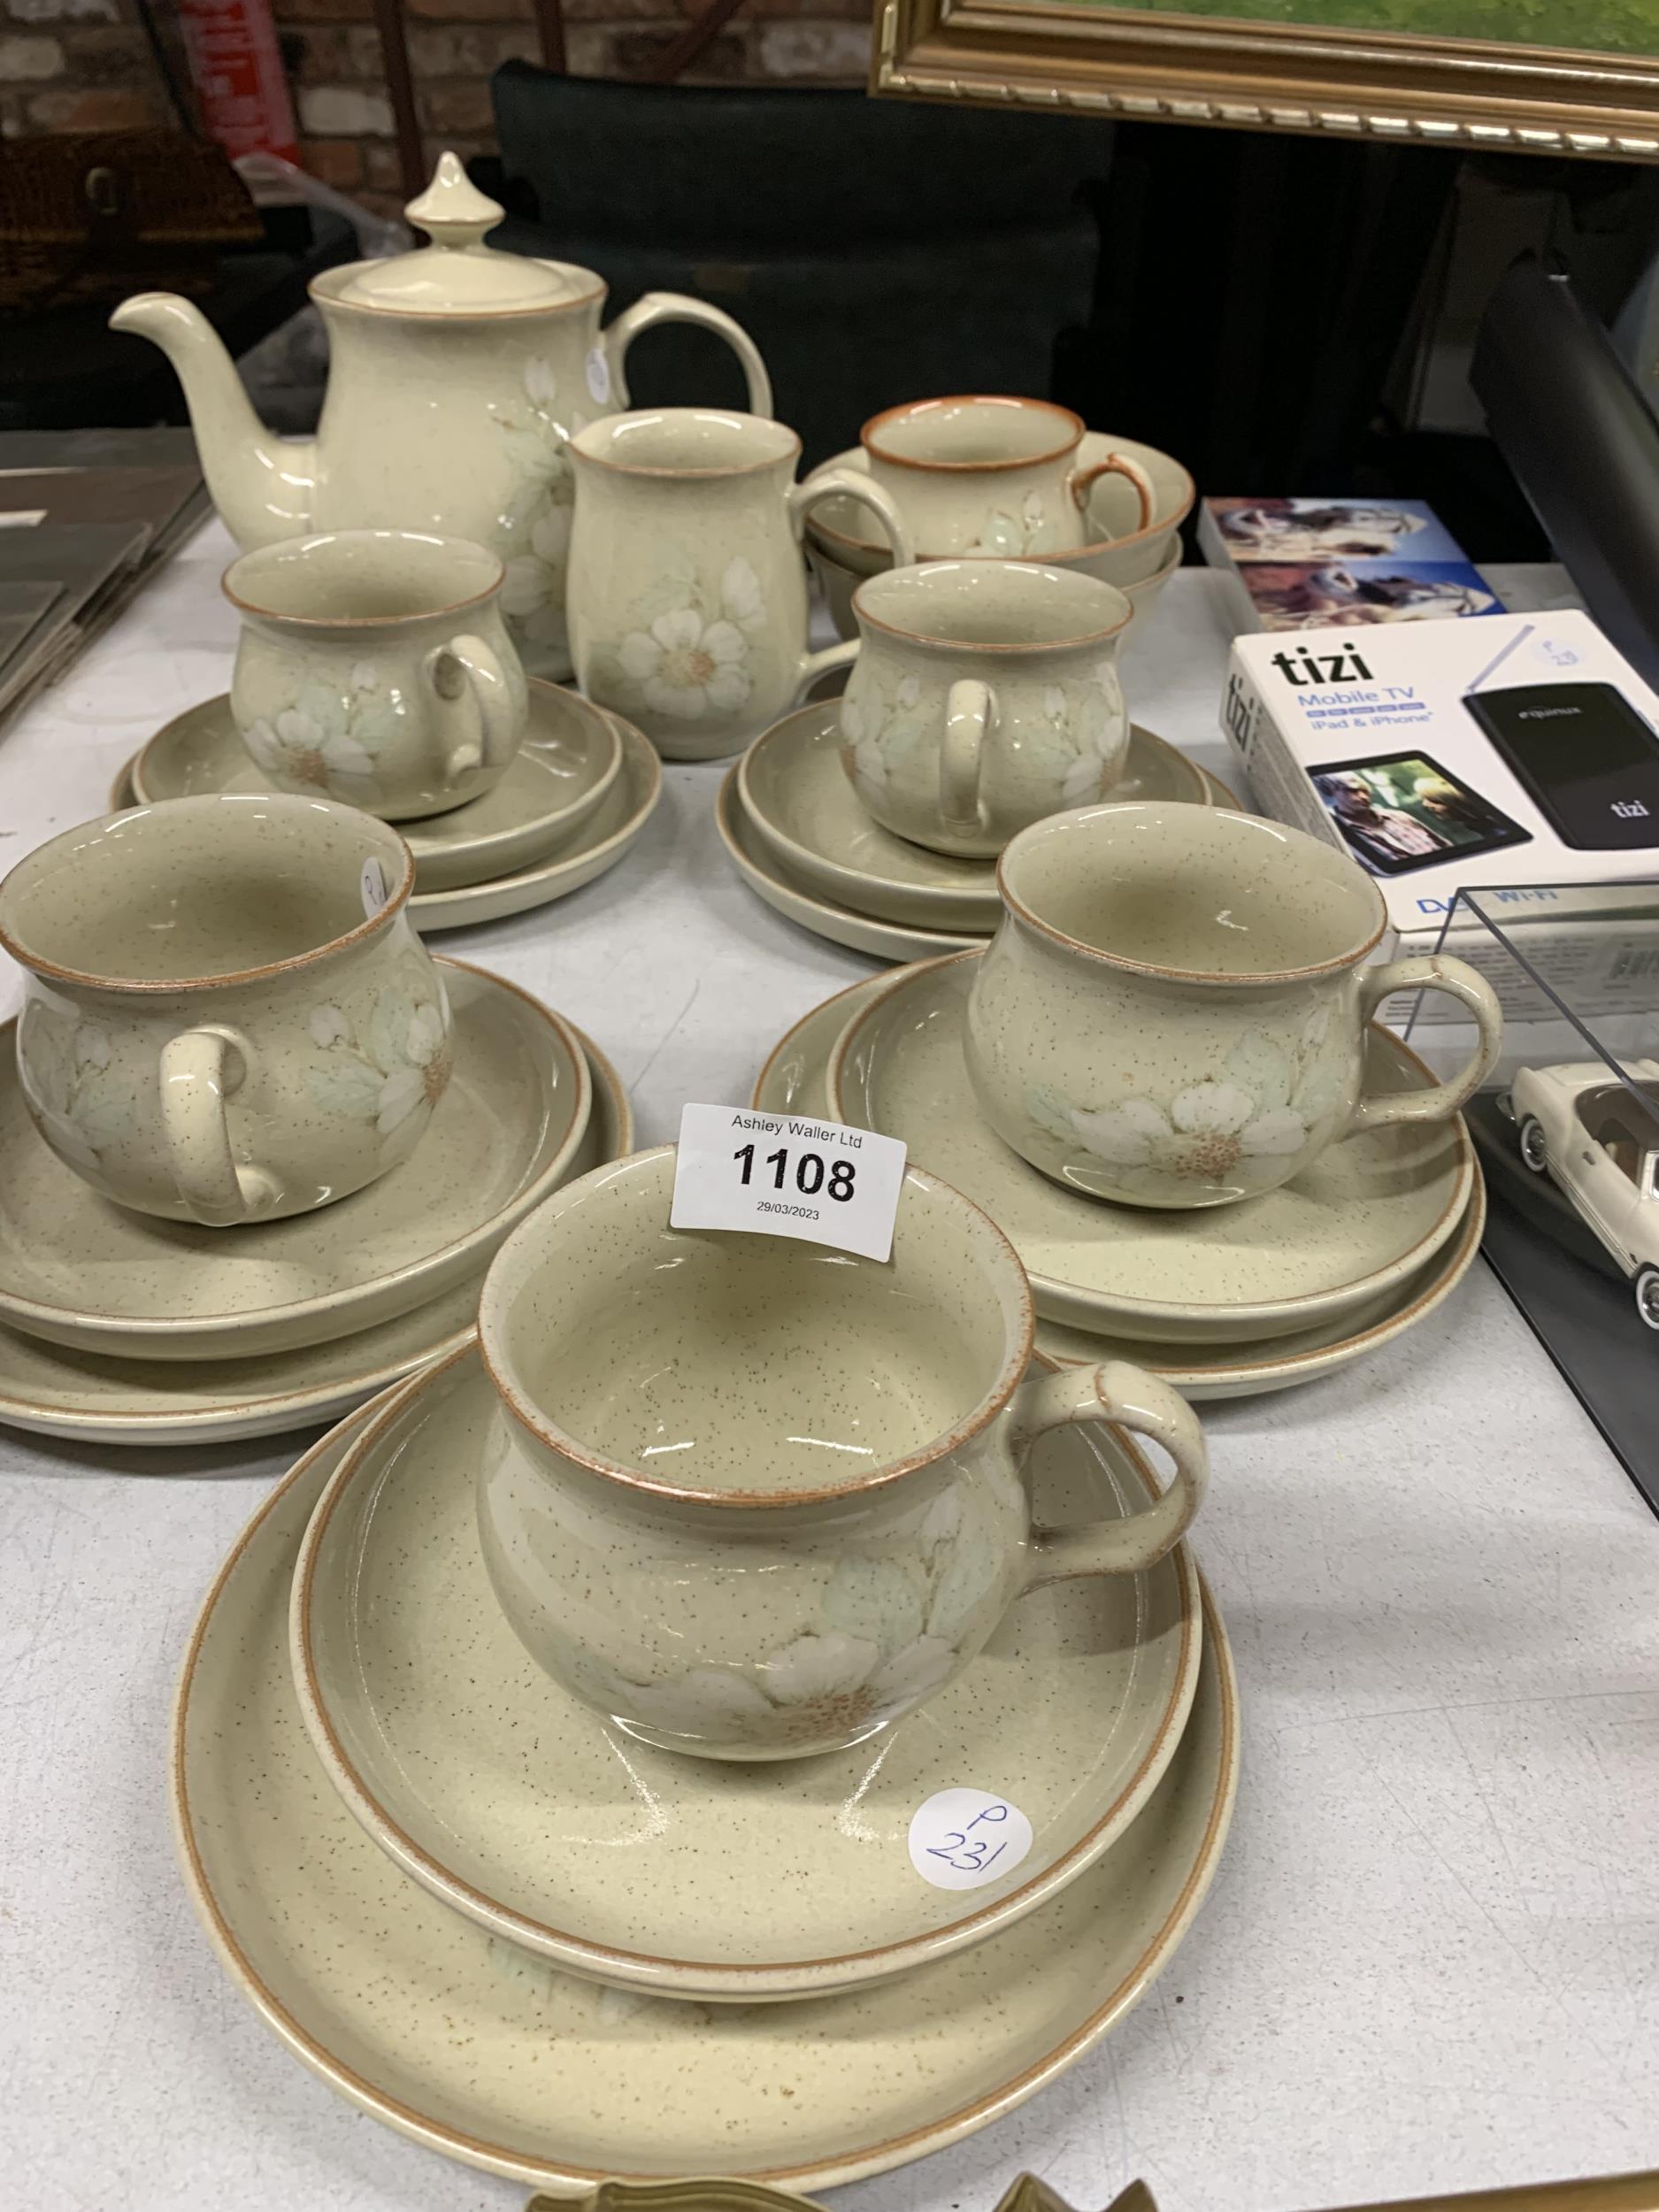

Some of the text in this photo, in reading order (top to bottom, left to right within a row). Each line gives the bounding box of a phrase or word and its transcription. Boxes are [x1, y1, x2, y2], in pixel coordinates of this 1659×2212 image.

[1271, 642, 1374, 686] tizi
[1297, 686, 1414, 707] Mobile TV
[1311, 719, 1349, 730] iPad
[1353, 718, 1367, 727] &
[1610, 800, 1650, 818] tizi
[1492, 890, 1558, 902] Wi-Fi
[731, 1115, 863, 1148] Ashley Waller Ltd
[733, 1143, 856, 1202] 1108
[757, 1201, 820, 1220] 29/03/2023
